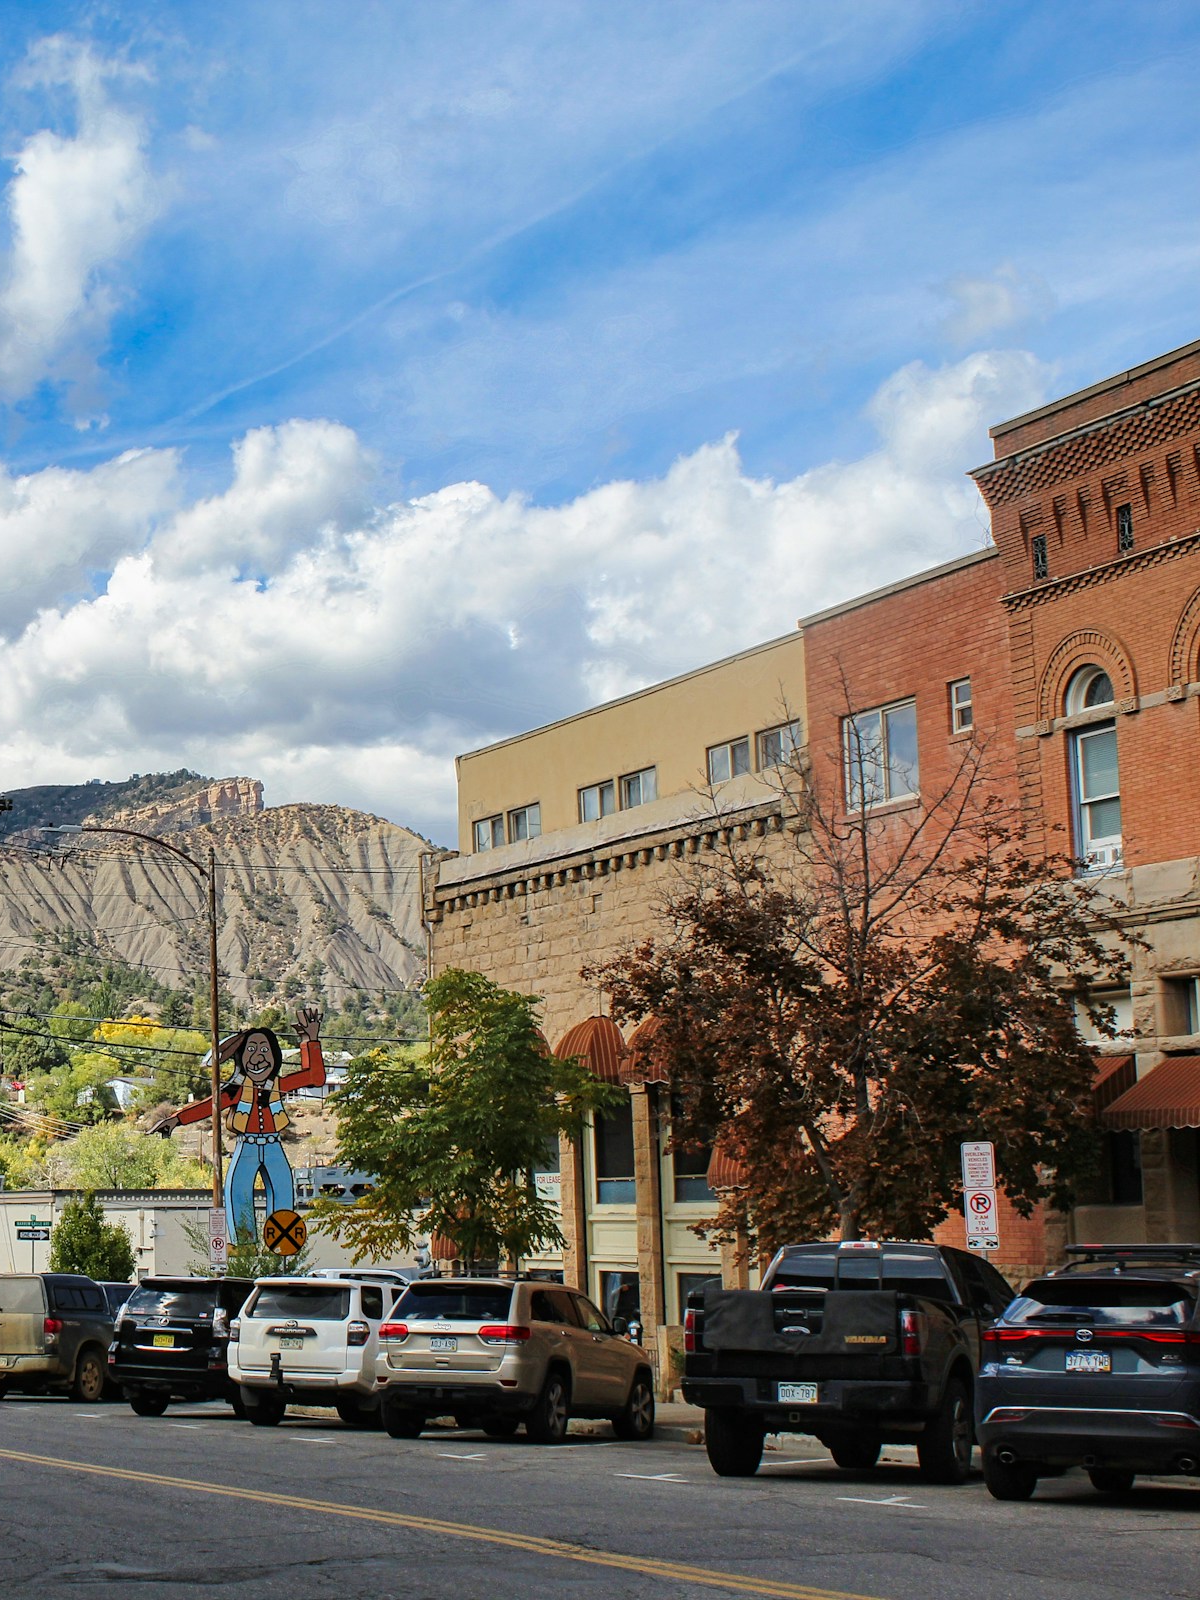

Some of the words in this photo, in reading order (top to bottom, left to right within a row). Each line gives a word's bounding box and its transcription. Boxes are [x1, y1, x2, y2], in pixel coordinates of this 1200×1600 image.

[536, 1176, 545, 1184] FOR
[546, 1175, 561, 1184] LEASE
[266, 1227, 275, 1239] R
[294, 1227, 304, 1239] R
[843, 1335, 887, 1344] YAKIMA
